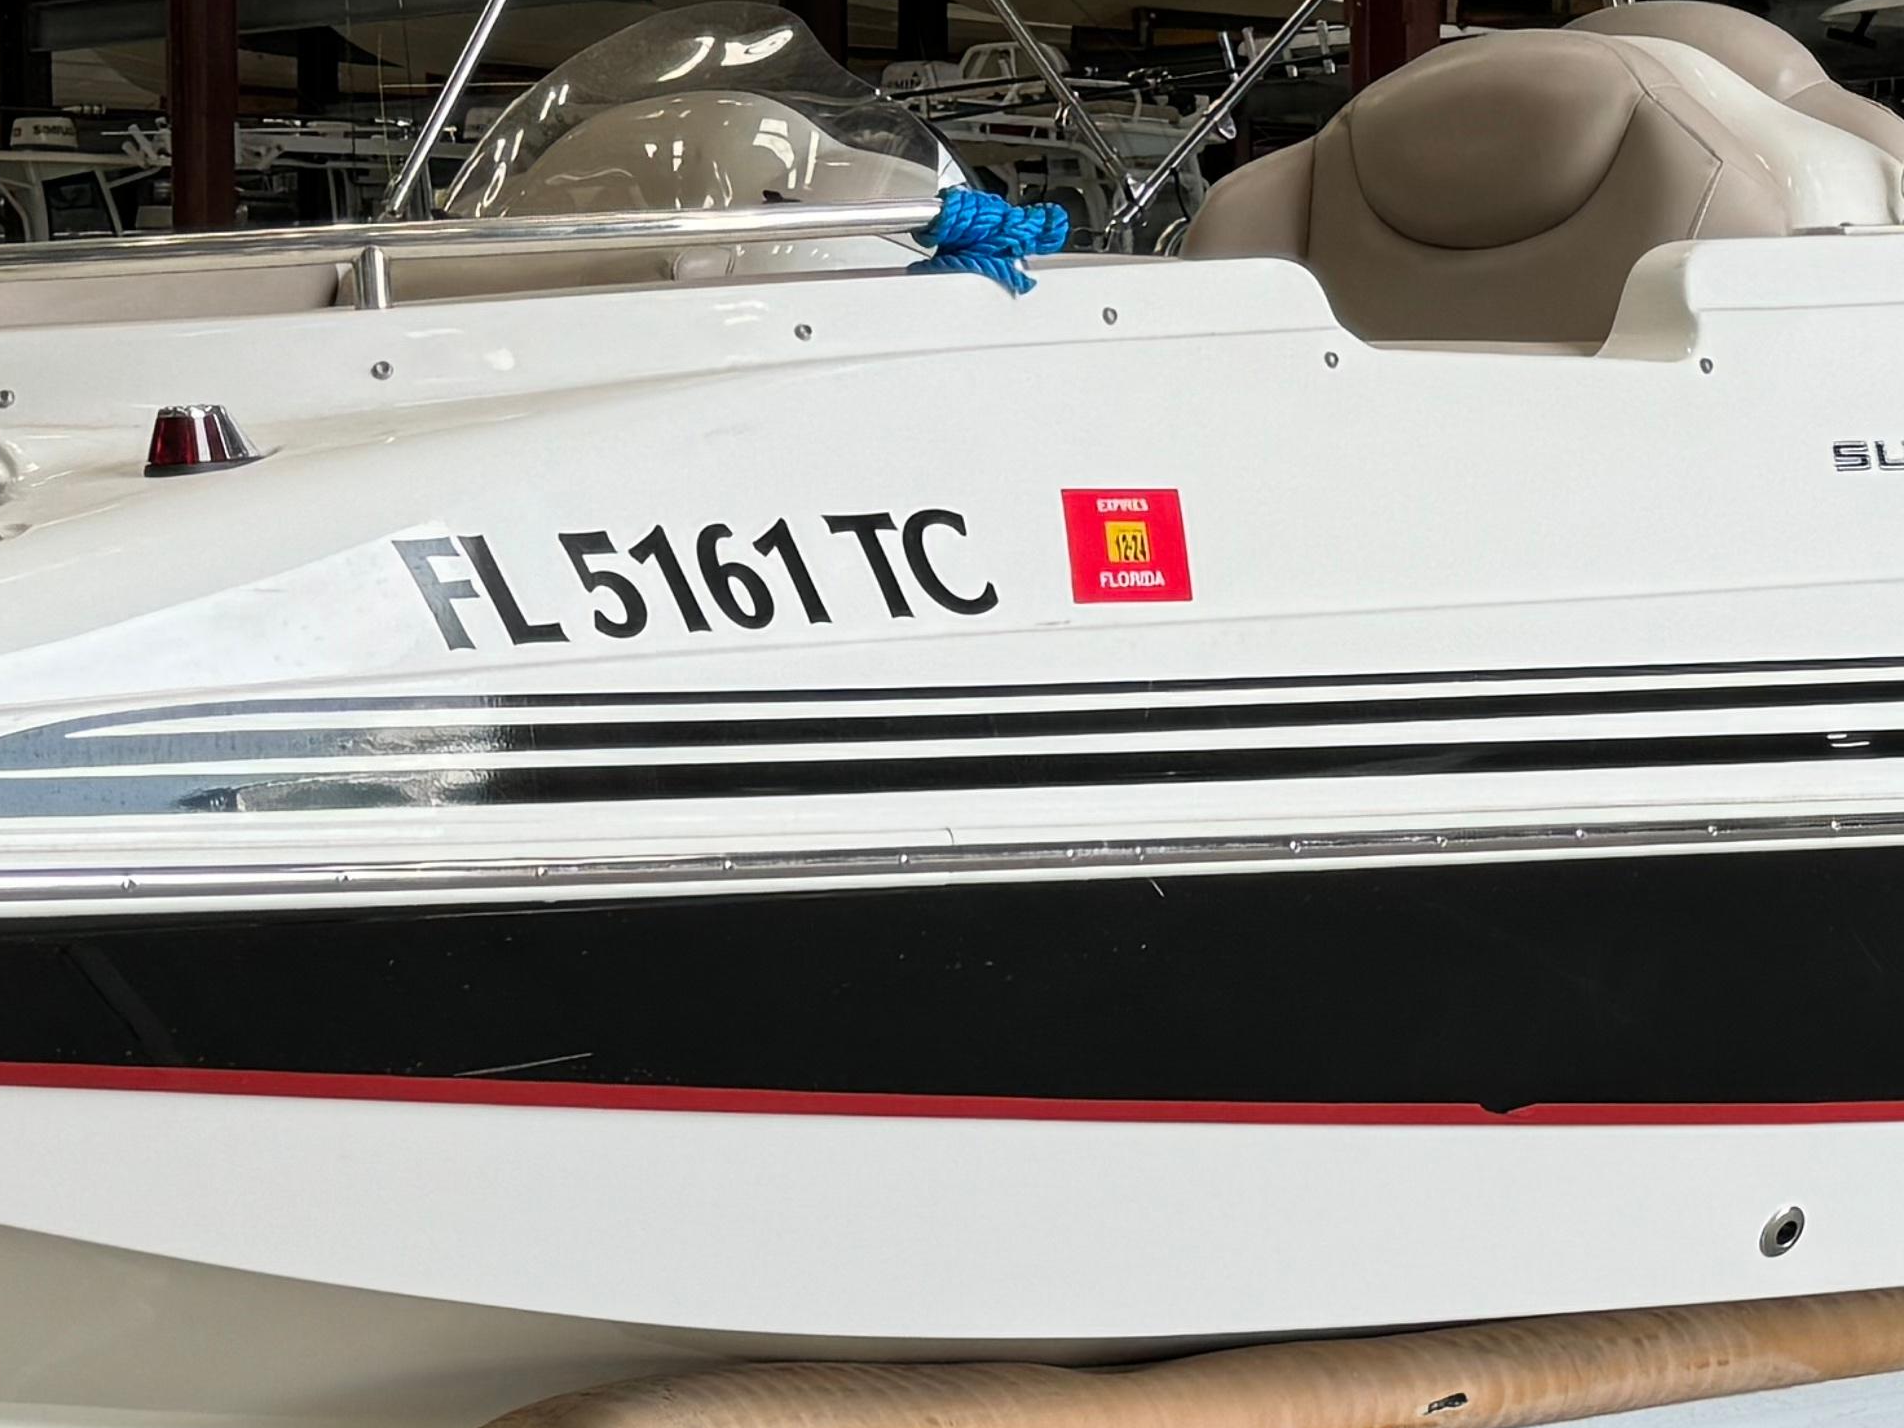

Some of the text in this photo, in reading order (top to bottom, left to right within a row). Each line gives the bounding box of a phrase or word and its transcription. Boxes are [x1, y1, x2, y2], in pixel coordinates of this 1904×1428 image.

[392, 508, 1001, 653] FL 5161 TC
[1099, 570, 1165, 589] FLORIDA
